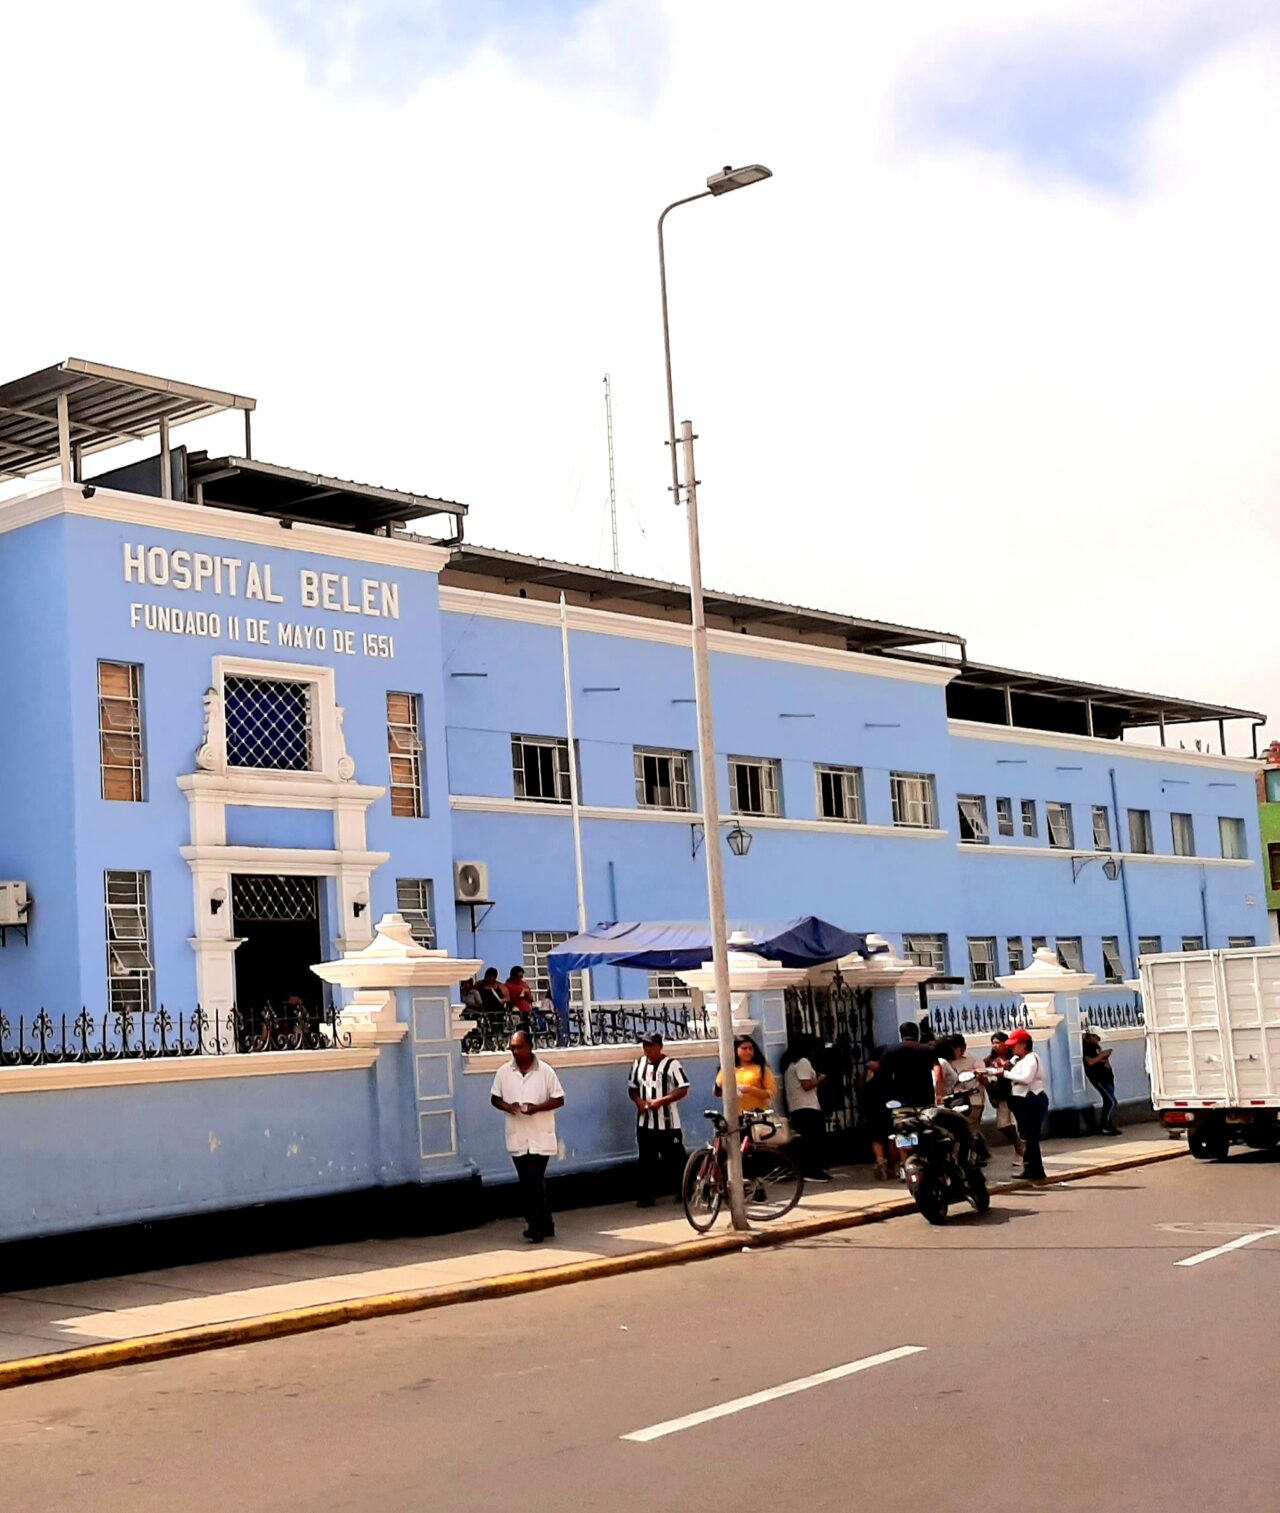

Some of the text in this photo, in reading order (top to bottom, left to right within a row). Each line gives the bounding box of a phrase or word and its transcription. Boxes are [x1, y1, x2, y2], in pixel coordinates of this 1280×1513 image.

[123, 542, 400, 619] HOSPITAL BELEN
[130, 603, 221, 638] FUNDADO
[246, 618, 270, 644] DE
[278, 622, 326, 650] MAYO
[332, 630, 355, 655] DE
[362, 632, 395, 658] 1551
